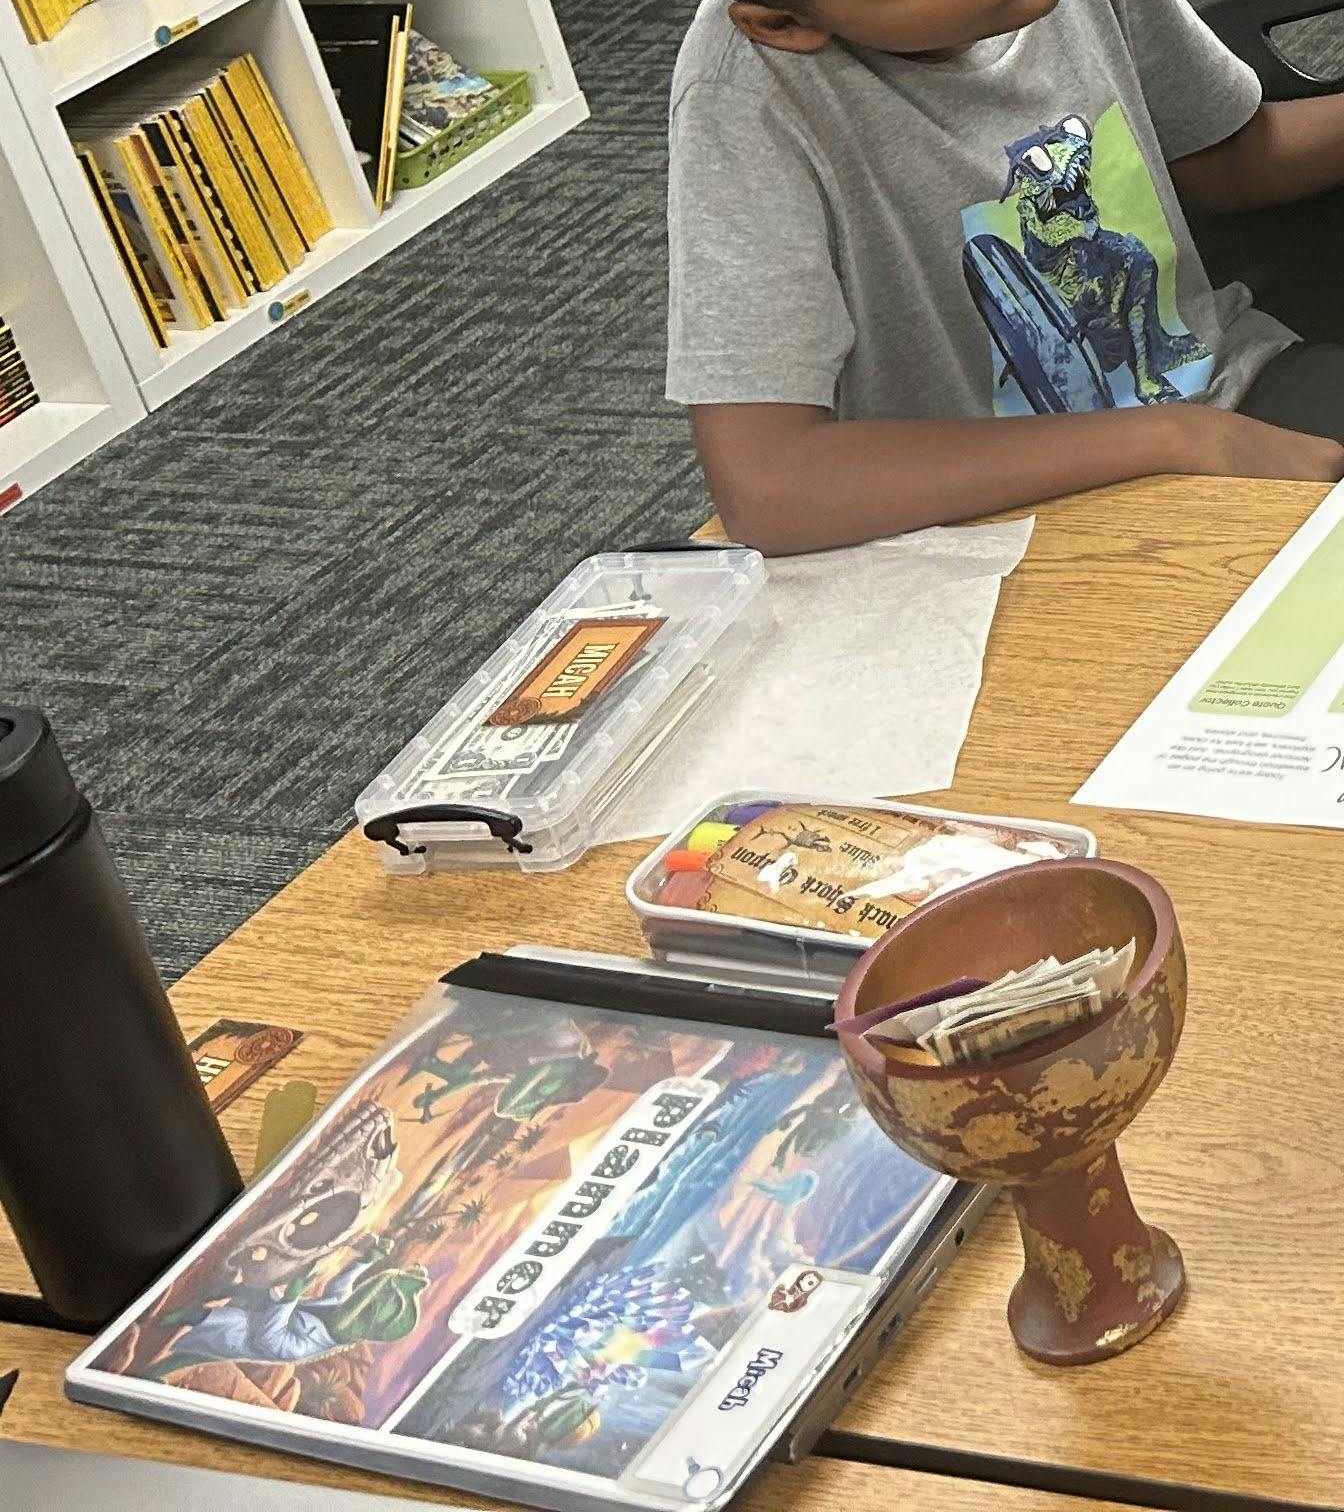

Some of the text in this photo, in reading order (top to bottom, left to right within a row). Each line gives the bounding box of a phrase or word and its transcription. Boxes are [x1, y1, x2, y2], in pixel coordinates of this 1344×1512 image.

[540, 642, 620, 699] MICAH
[1200, 698, 1286, 709] Quote Collector
[857, 902, 900, 930] nack
[717, 1347, 784, 1411] Micah
